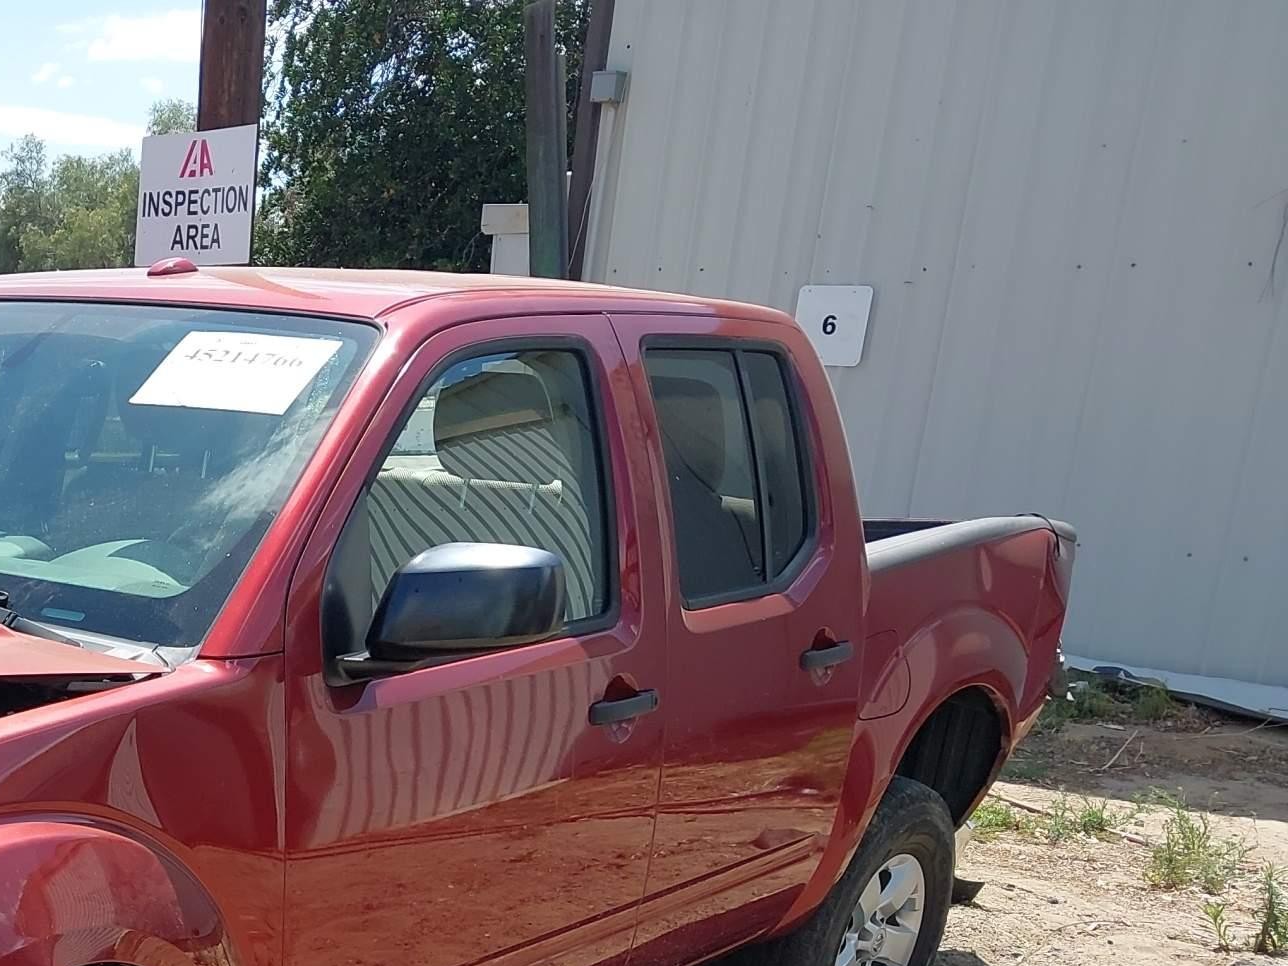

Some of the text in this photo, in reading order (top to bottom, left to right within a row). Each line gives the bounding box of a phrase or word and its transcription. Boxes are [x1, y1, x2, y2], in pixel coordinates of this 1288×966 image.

[141, 184, 249, 218] INSPECTION
[170, 223, 221, 251] AREA
[822, 314, 838, 335] 6
